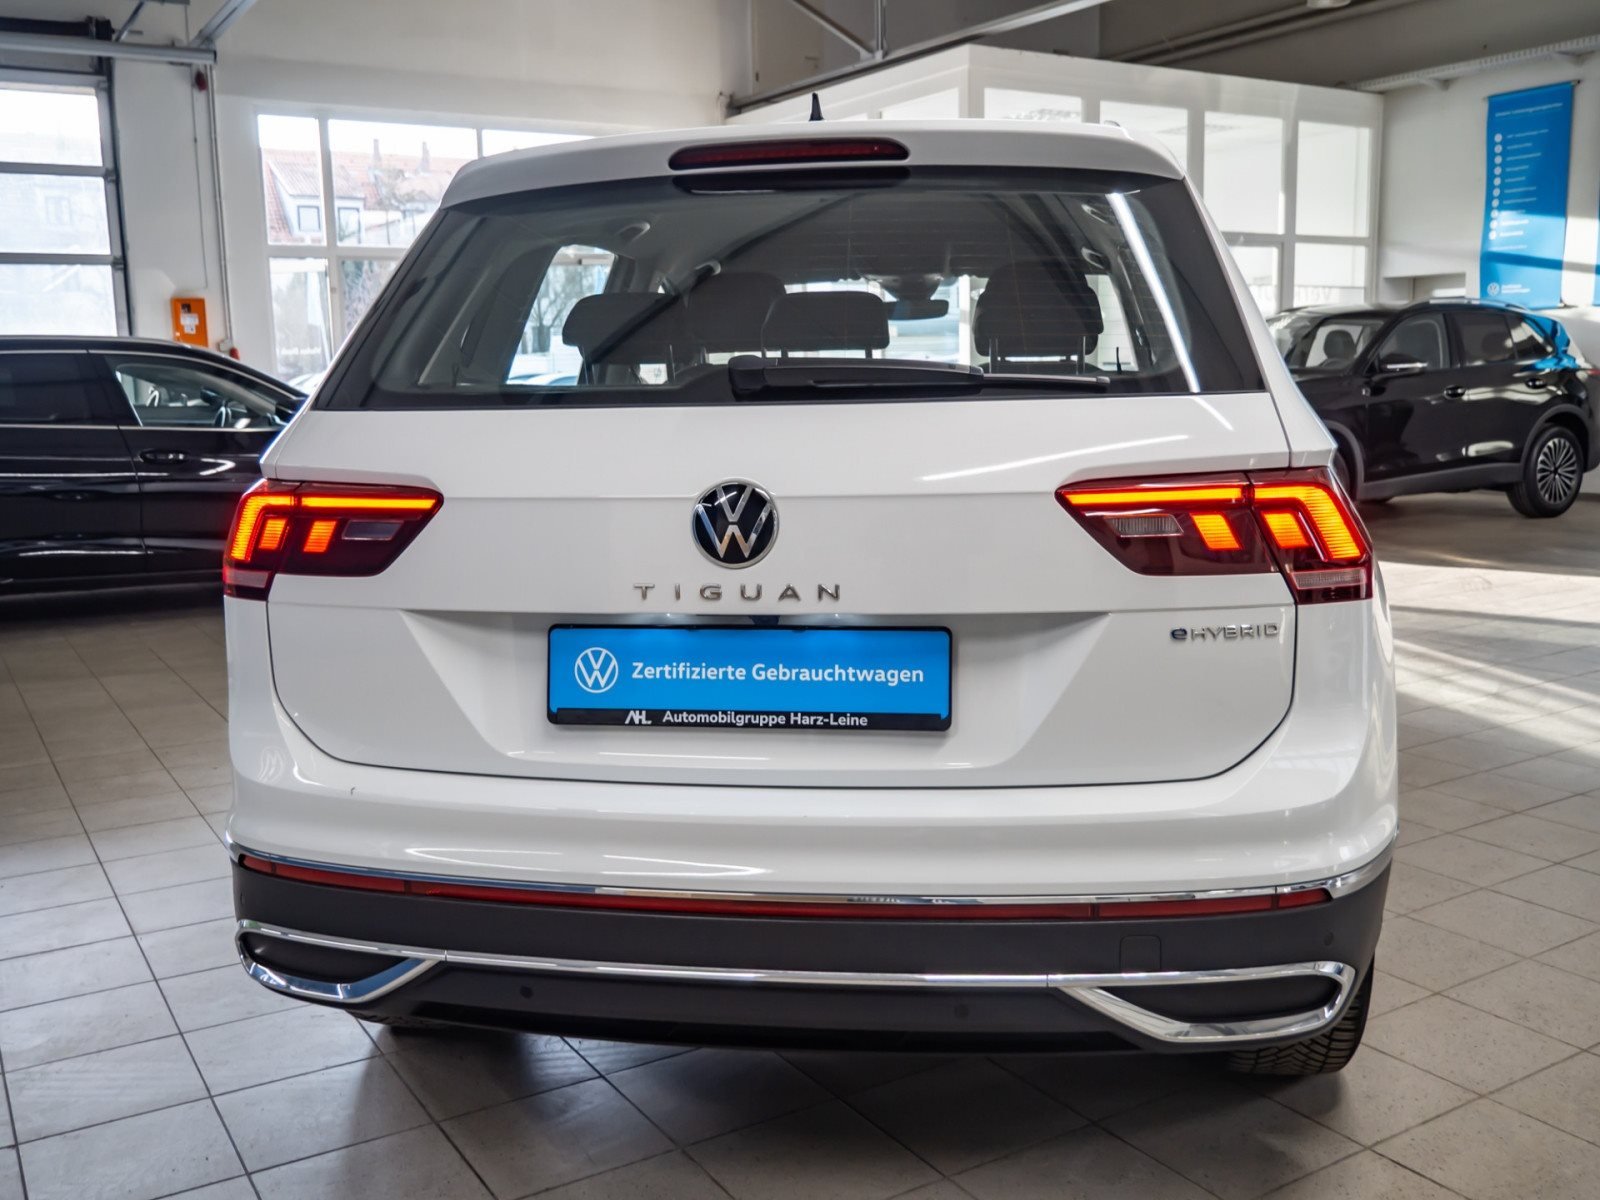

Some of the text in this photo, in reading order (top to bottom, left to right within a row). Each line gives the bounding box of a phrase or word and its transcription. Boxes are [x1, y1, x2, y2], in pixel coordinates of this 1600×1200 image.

[693, 480, 774, 560] VW
[633, 583, 841, 601] TIGUAN
[575, 648, 618, 692] VW
[632, 662, 925, 687] Zertifizierte Gebrauchtwagen
[662, 711, 786, 727] Automobilgruppe
[790, 712, 868, 726] Harz-Leine
